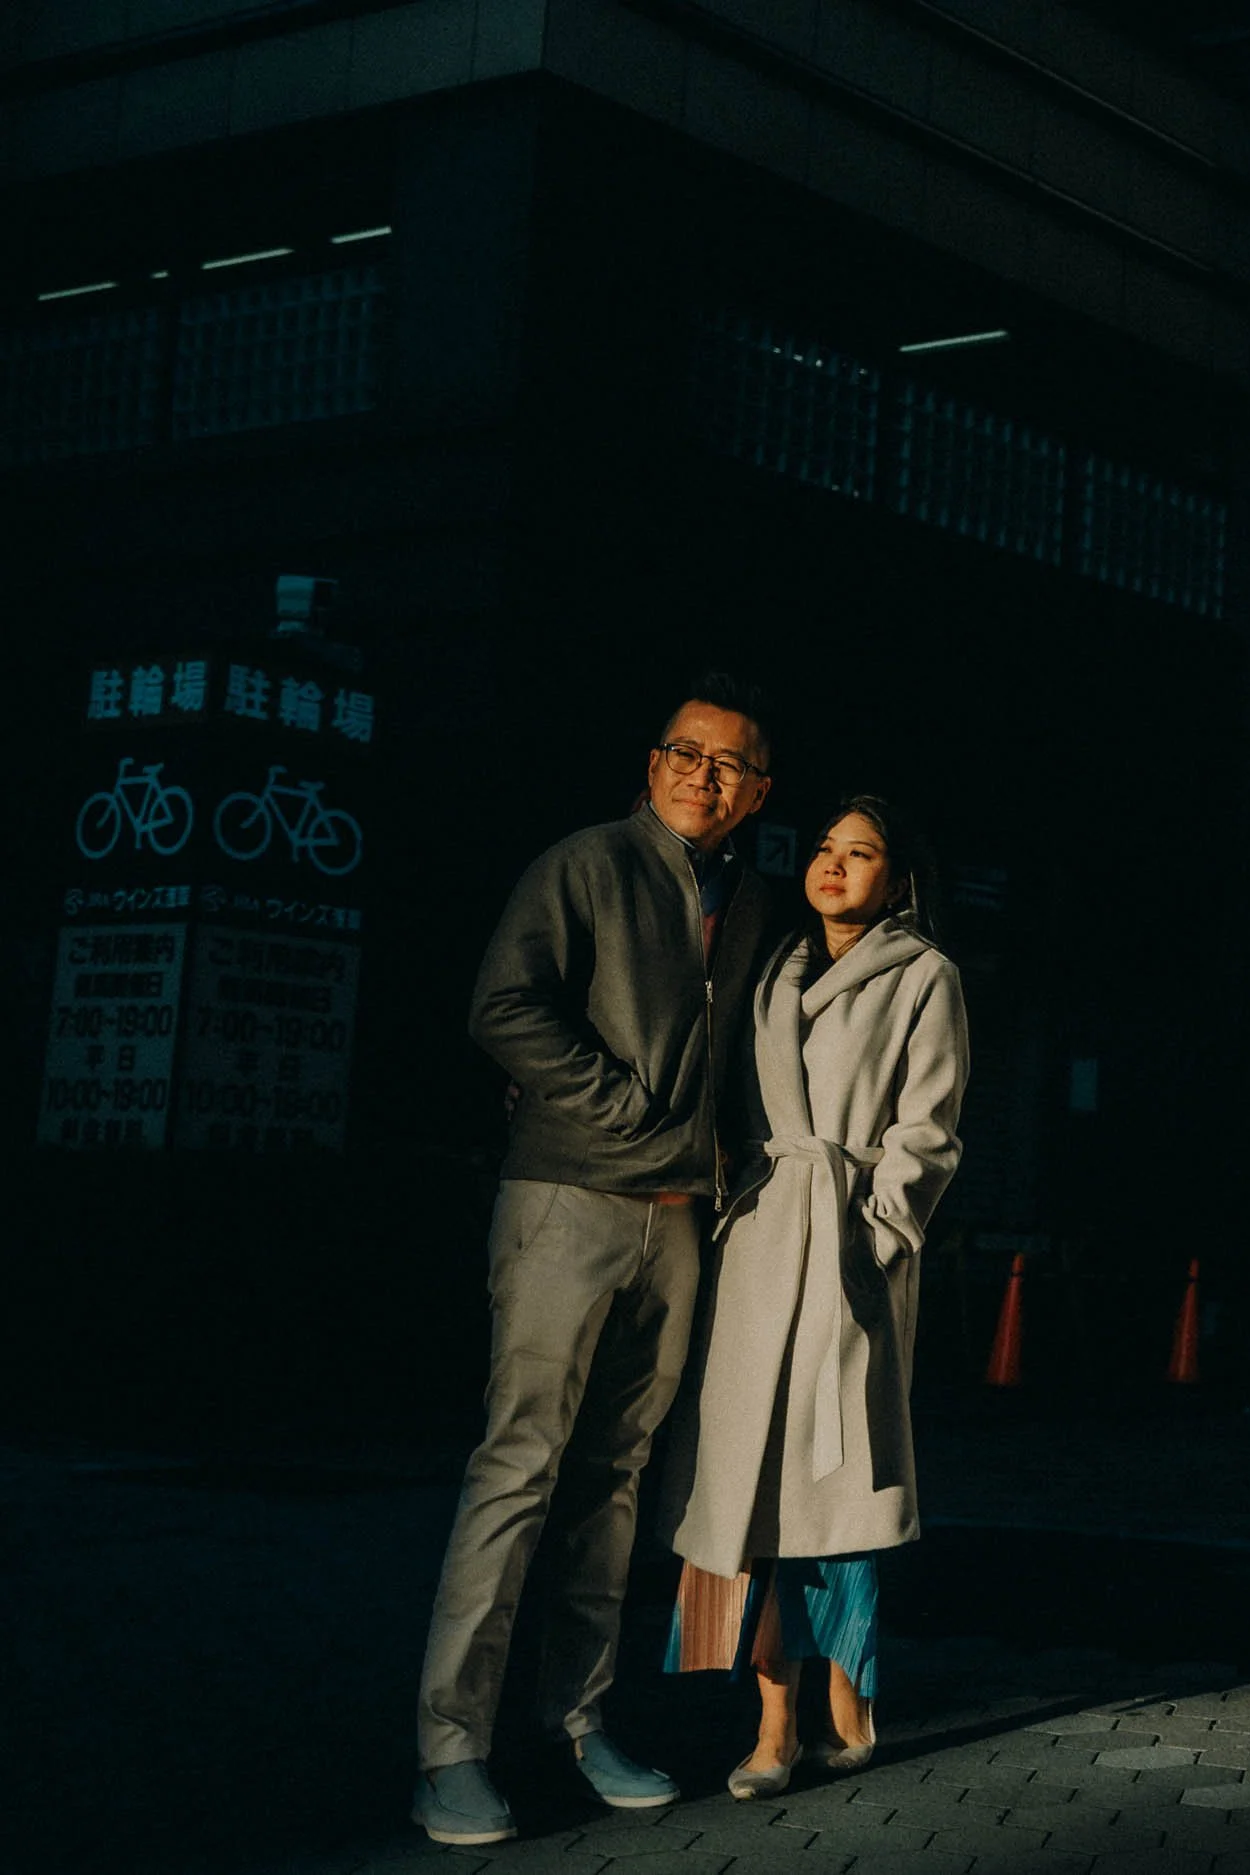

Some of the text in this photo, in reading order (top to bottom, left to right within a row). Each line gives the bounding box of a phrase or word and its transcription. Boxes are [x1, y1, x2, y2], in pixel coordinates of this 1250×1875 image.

[87, 659, 208, 720] 駐輪場
[224, 662, 375, 744] 駐輪場
